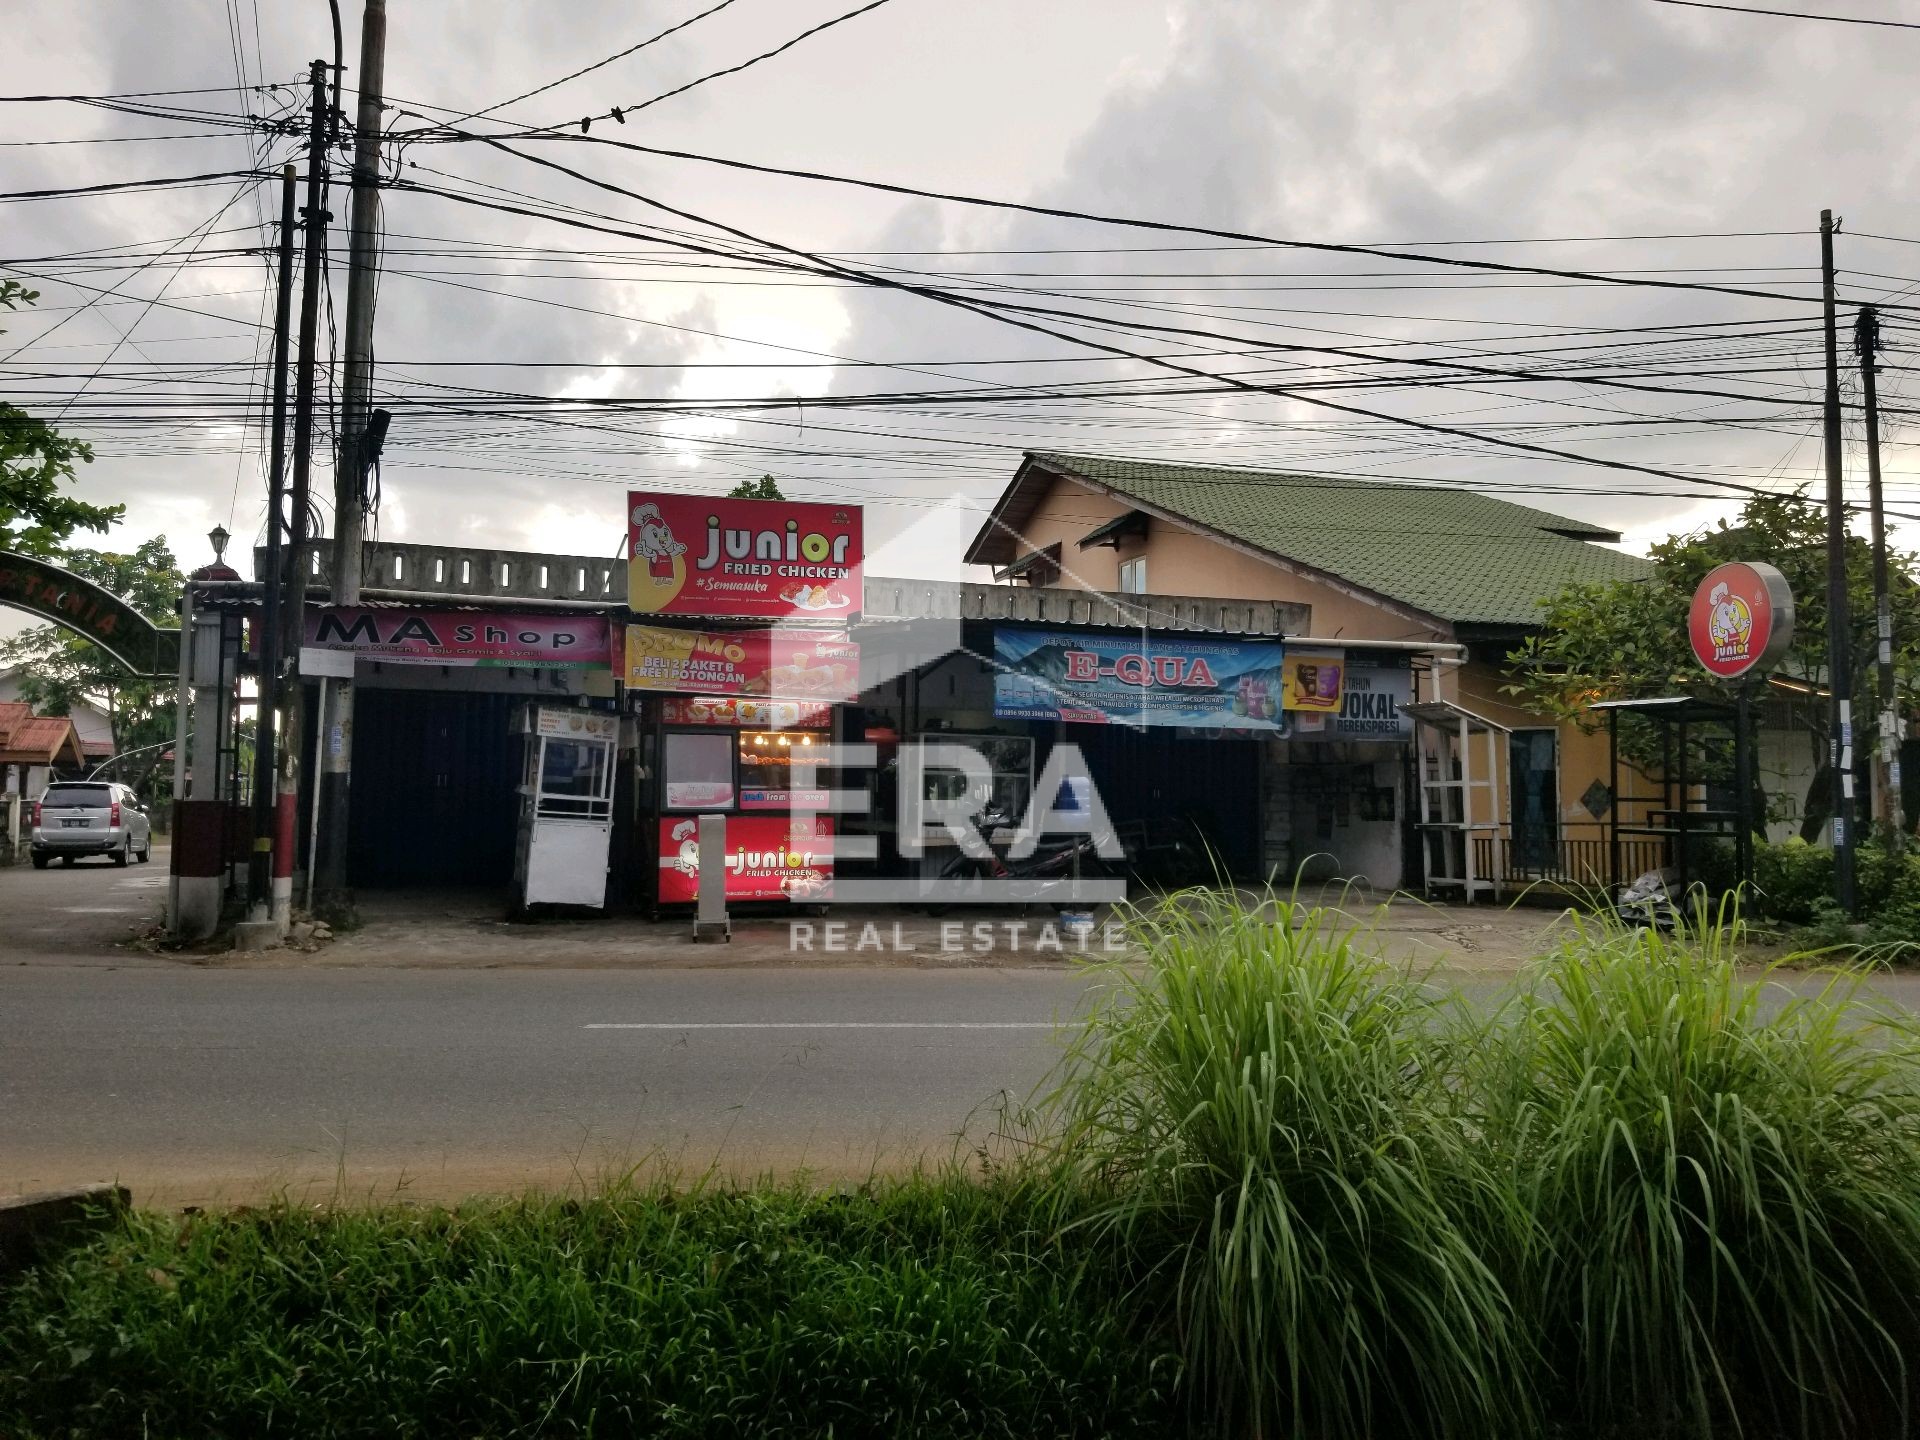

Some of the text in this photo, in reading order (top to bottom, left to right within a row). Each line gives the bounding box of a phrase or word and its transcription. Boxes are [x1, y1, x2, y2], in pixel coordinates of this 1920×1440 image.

[696, 515, 850, 571] junior
[724, 562, 850, 580] FRIED CHICKEN
[696, 577, 769, 594] #Semuasuka
[314, 612, 444, 647] MA
[455, 624, 577, 649] Shop
[633, 633, 747, 664] PROMO
[1041, 637, 1073, 647] DEPOT
[1091, 641, 1127, 650] MINUM
[1713, 642, 1749, 661] junior
[643, 656, 671, 669] BELI
[672, 659, 680, 670] 2
[682, 659, 725, 672] PAKET
[1064, 651, 1220, 688] E-QUA
[632, 666, 662, 678] FREE
[671, 669, 746, 684] POTONGAN
[1348, 677, 1371, 691] TAHUN
[766, 791, 786, 801] from
[804, 793, 825, 801] oven
[732, 846, 813, 876] junior
[746, 869, 813, 877] FRIED CHICKEN
